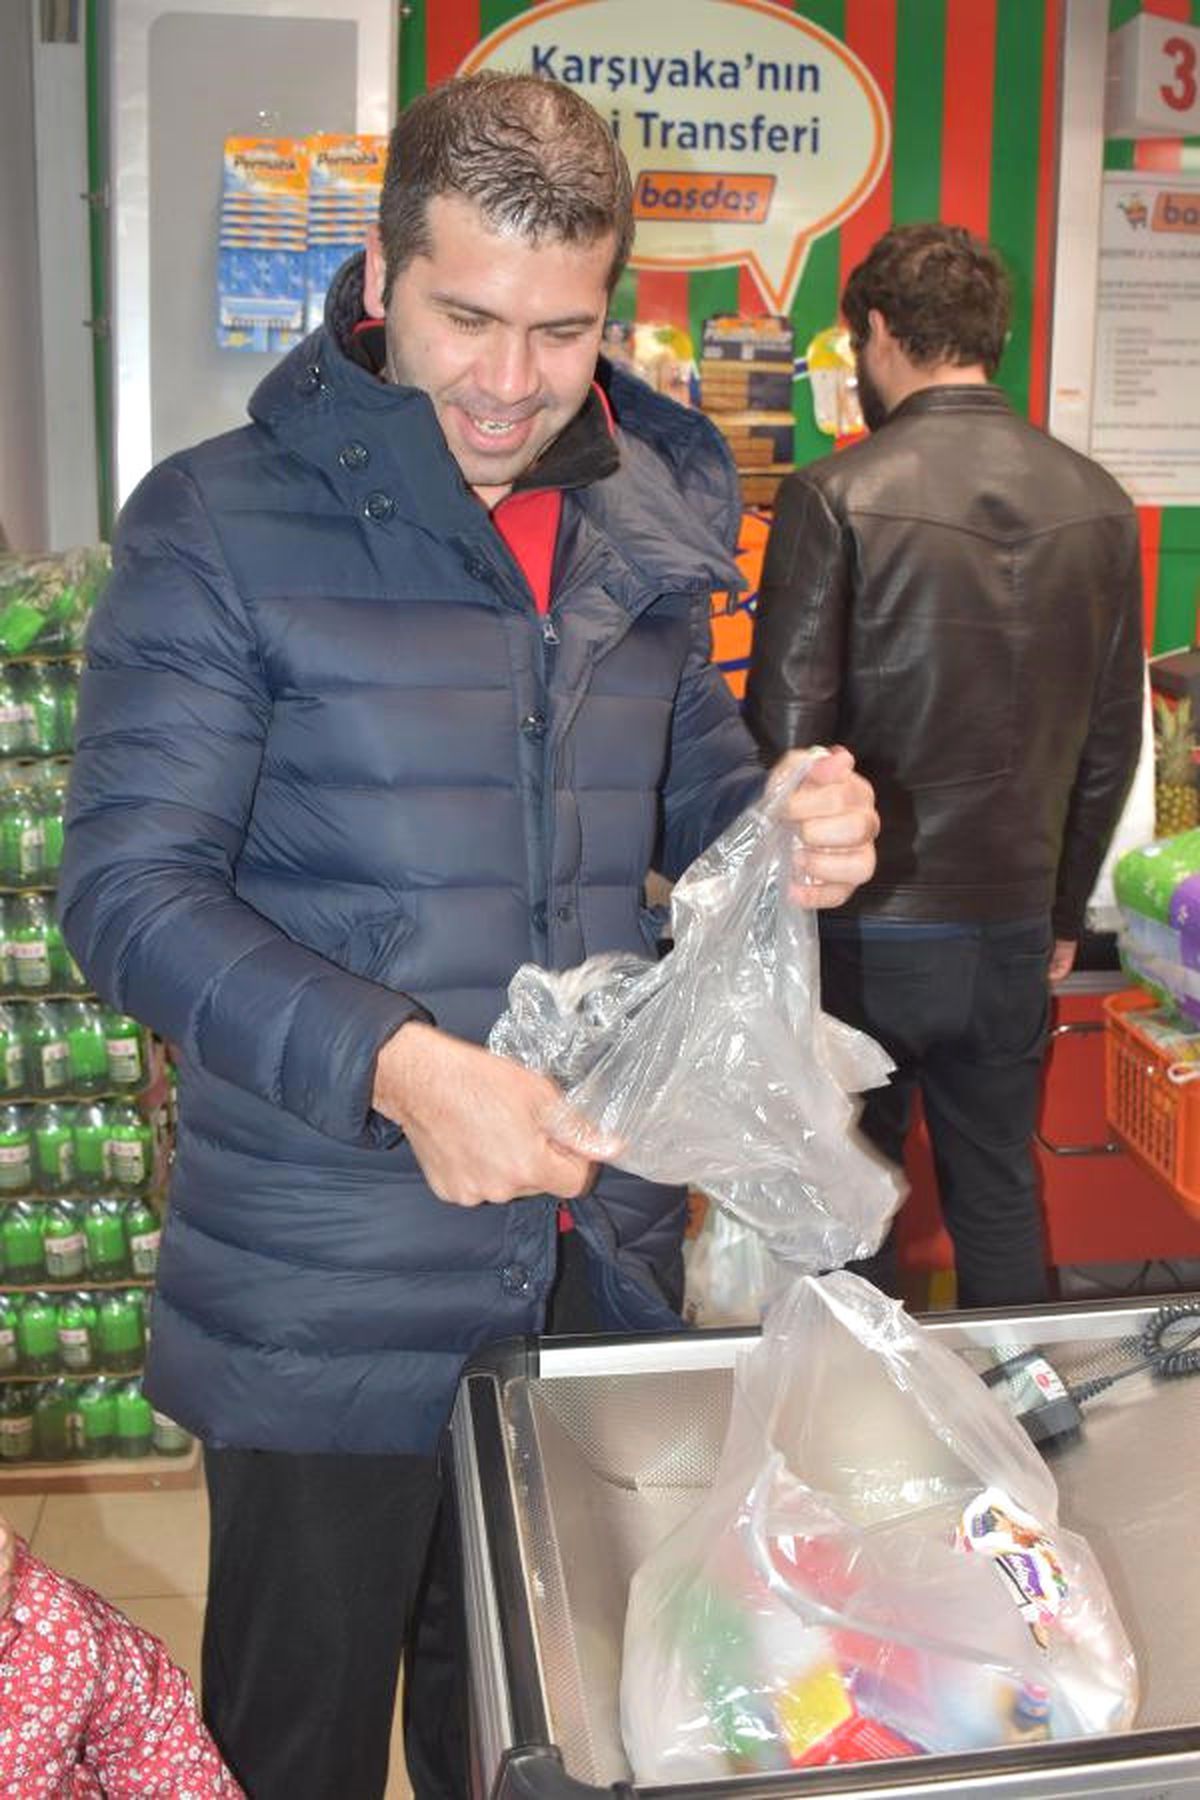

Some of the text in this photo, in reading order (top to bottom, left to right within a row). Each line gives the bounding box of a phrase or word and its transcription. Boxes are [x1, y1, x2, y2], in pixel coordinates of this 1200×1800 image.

[1160, 36, 1197, 111] 3
[635, 112, 820, 153] Transferi
[641, 176, 758, 213] başdaş
